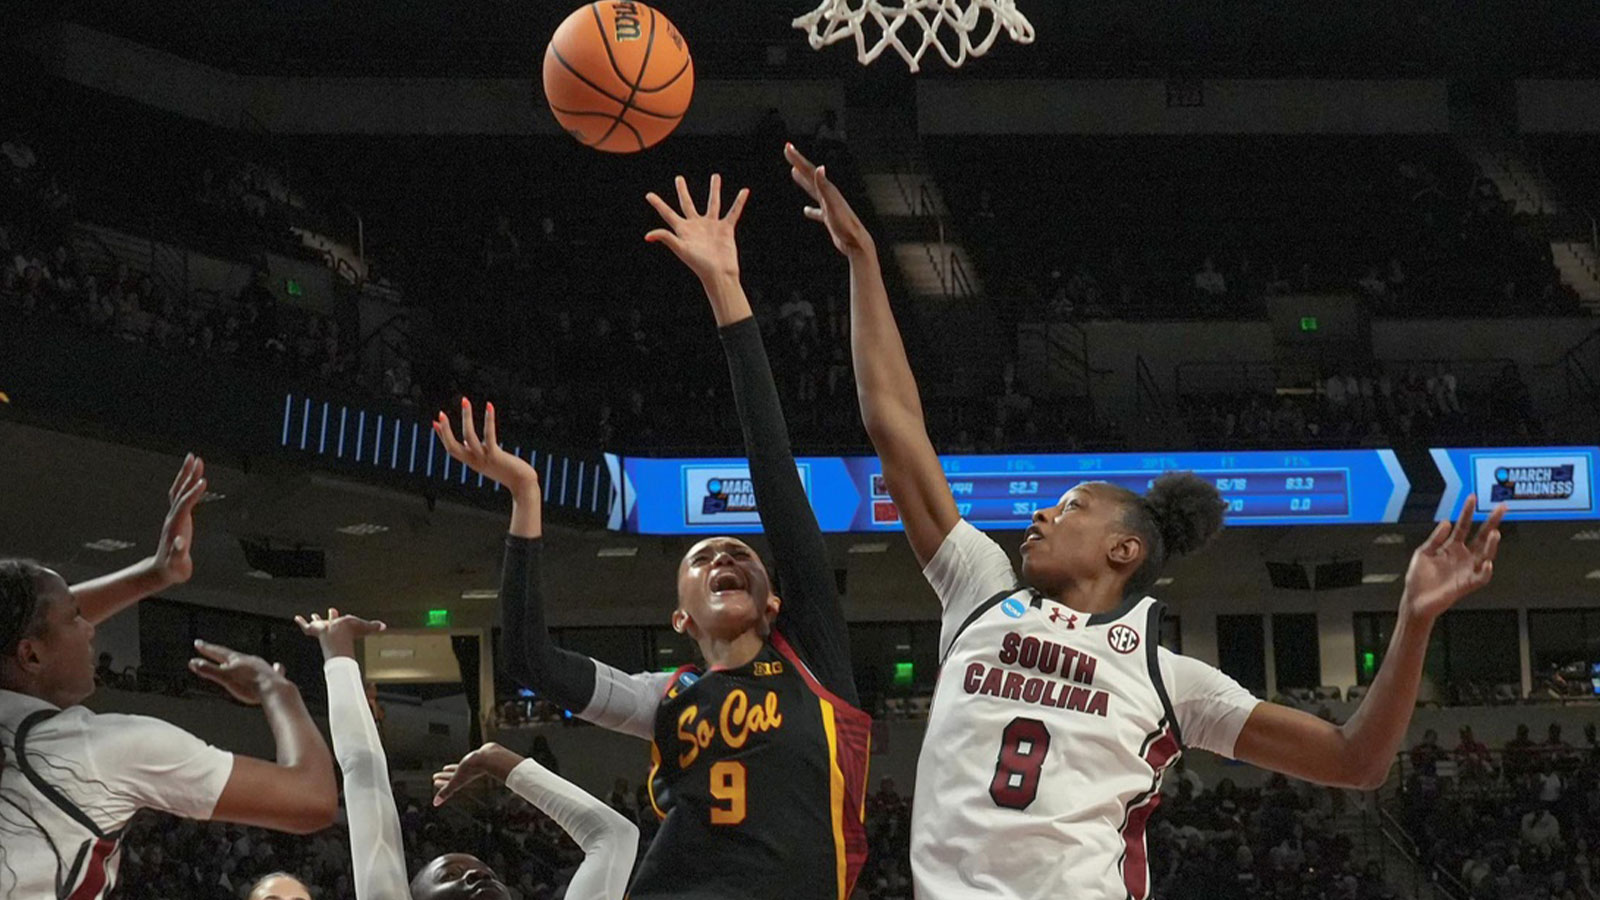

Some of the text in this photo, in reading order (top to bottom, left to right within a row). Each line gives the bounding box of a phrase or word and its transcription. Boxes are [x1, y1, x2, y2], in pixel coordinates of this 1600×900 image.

[1508, 468, 1552, 482] MARCH
[721, 480, 753, 494] MAR
[1009, 481, 1038, 494] 52.3
[1514, 481, 1573, 495] MADNESS
[728, 493, 756, 507] MAD
[1290, 498, 1311, 511] 0.0
[1109, 625, 1138, 651] SEC
[999, 632, 1097, 685] SOUTH
[963, 663, 1110, 717] CAROLINA
[677, 688, 783, 769] So Cal
[989, 716, 1051, 811] 8
[709, 760, 747, 825] 9
